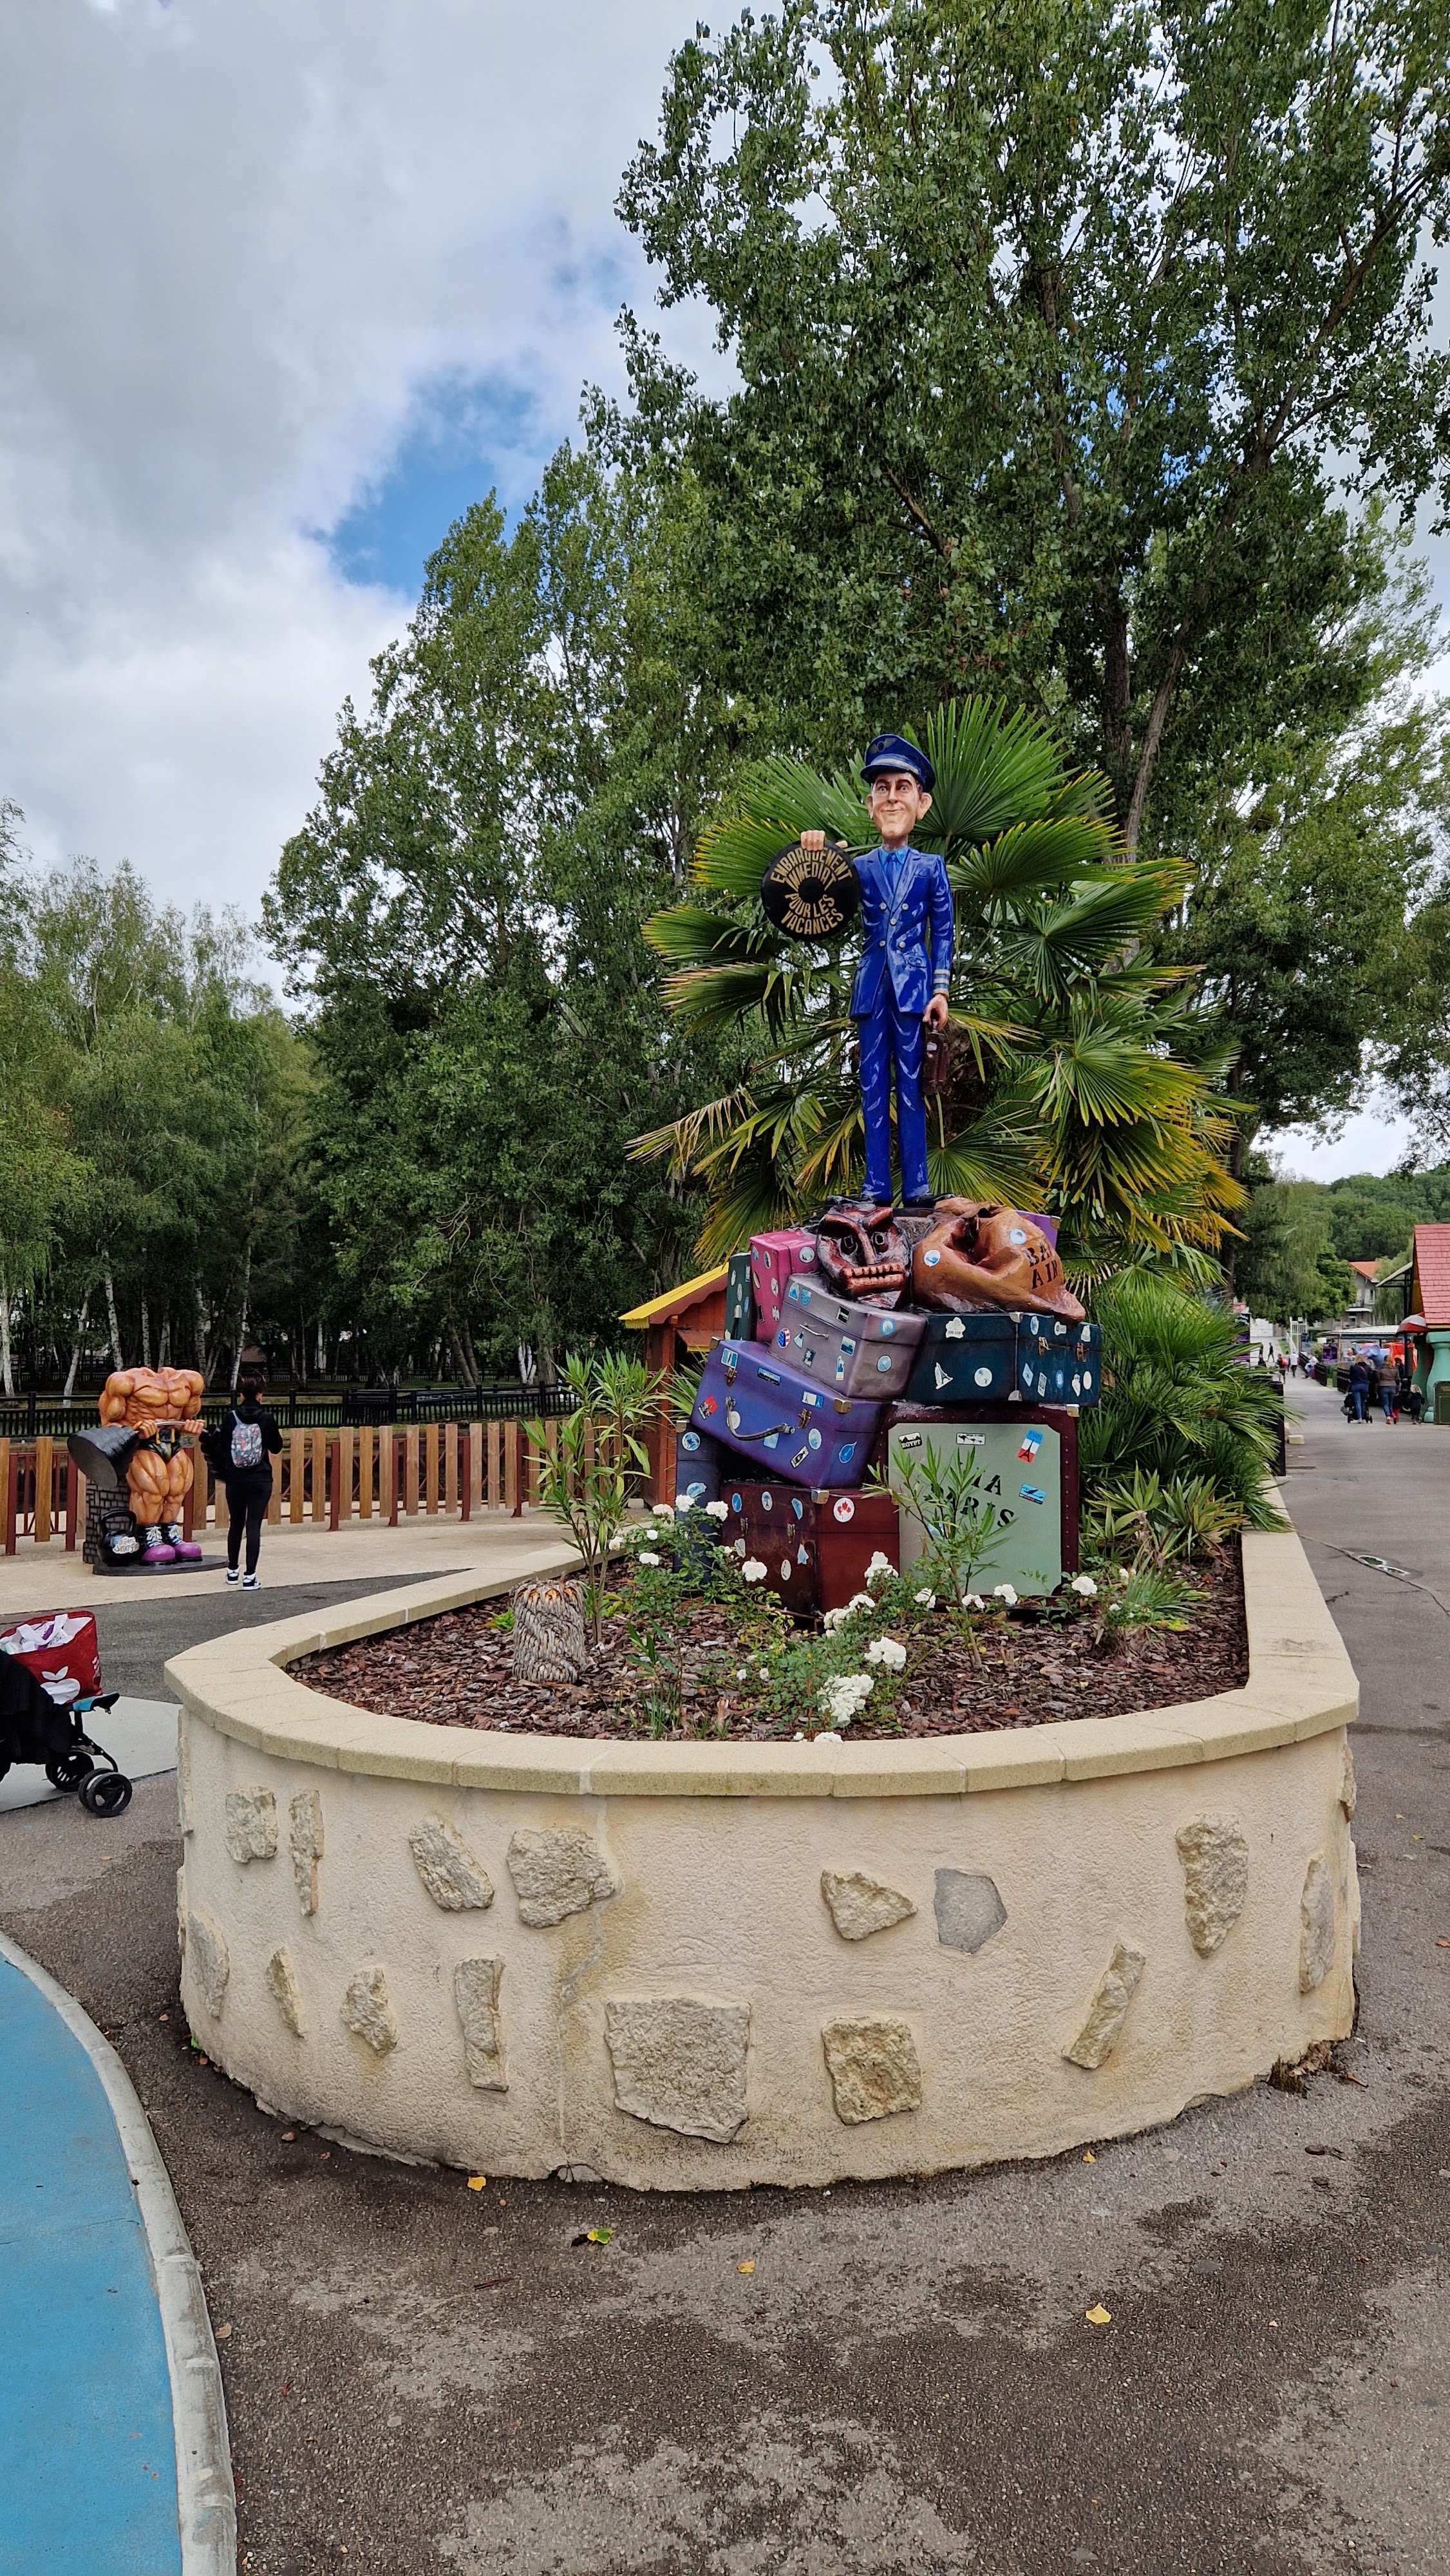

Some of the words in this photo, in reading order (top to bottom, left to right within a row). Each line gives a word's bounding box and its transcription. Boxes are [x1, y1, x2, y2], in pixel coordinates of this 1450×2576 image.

[785, 893, 811, 918] POUR
[813, 894, 835, 918] LES
[780, 908, 844, 935] VACANCES
[925, 1482, 1015, 1528] PARS
